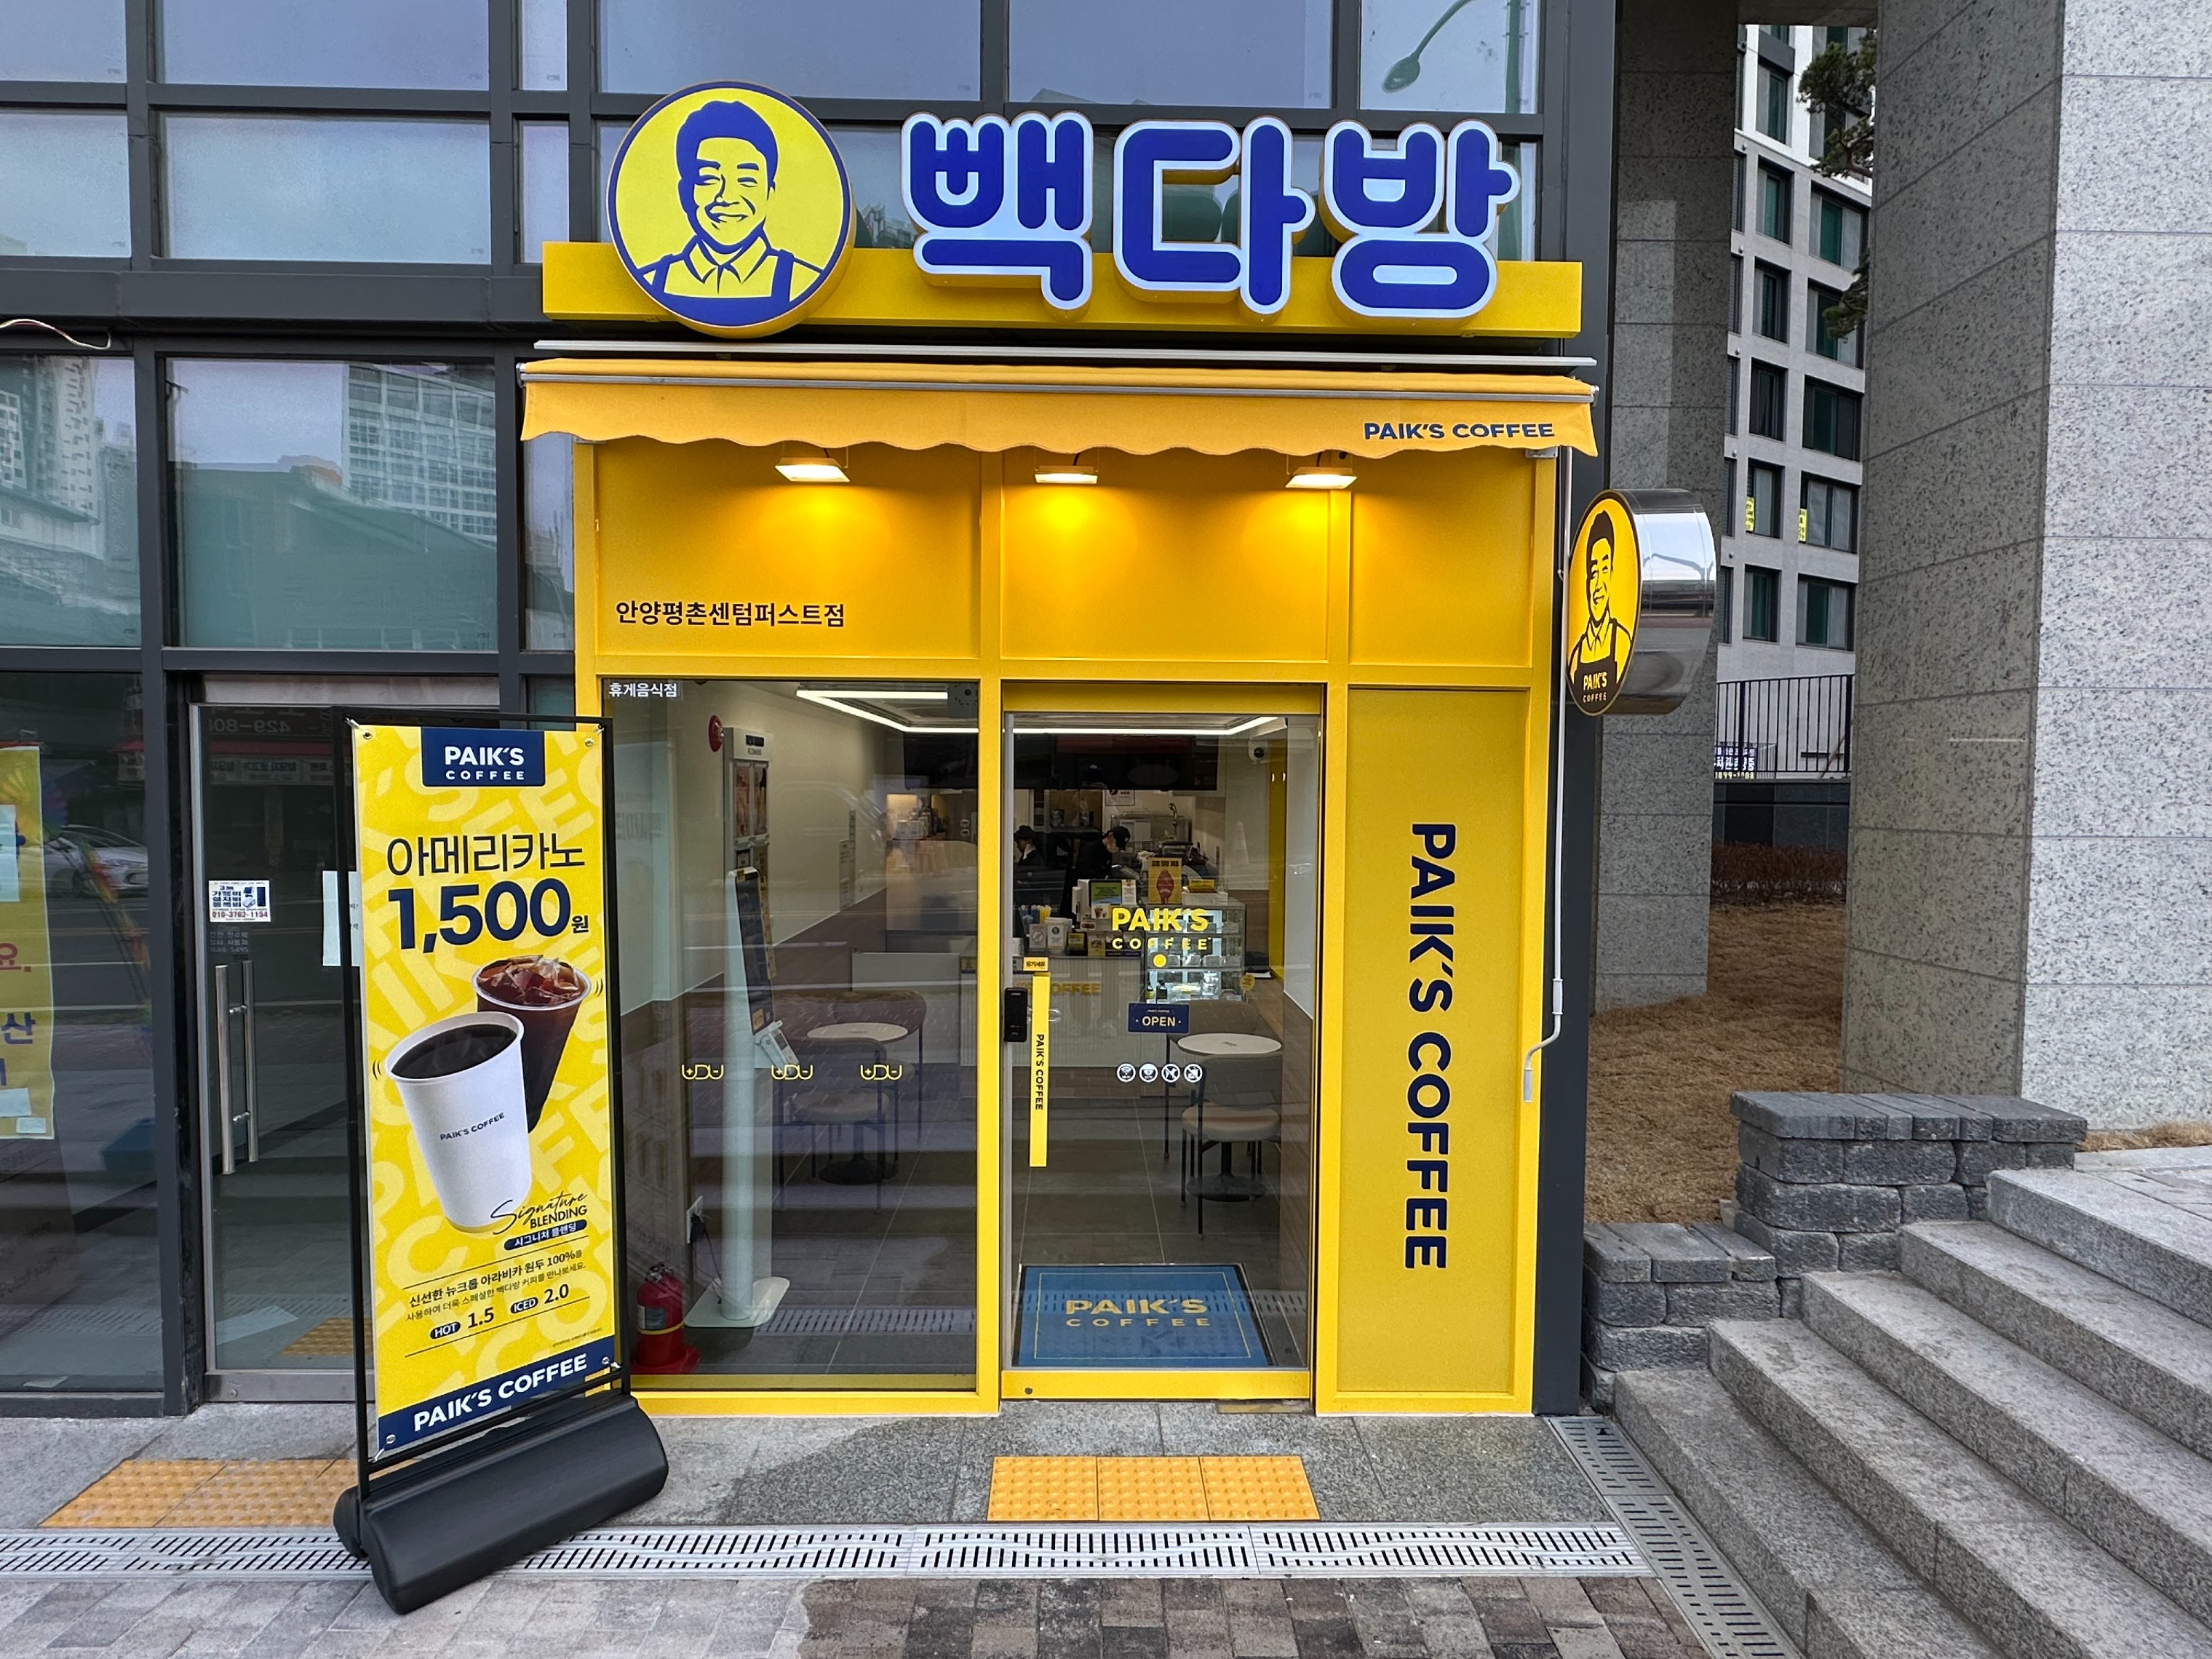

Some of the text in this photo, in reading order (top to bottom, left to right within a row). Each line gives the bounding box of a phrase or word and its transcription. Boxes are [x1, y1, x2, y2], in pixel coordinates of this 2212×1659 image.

[901, 111, 1521, 319] 백다방
[1364, 422, 1555, 439] PAIK'S COFFEE
[616, 600, 846, 628] 안양평촌센텀퍼스트점
[608, 682, 678, 698] 휴게음식점
[1583, 671, 1608, 691] PAIK'S
[1582, 691, 1607, 704] COFFEE
[445, 746, 525, 766] PAIK'S
[445, 770, 525, 781] COFFEE
[387, 832, 586, 877] 아메리카노
[1112, 907, 1209, 931] PAIK'S
[1112, 937, 1209, 950] COFFEE
[1050, 982, 1102, 995] OFFEE
[1142, 1016, 1176, 1027] OPEN
[1405, 823, 1456, 1269] PAIK'S COFFEE
[1035, 1034, 1045, 1110] PAIK'S COFFEE
[439, 1112, 505, 1141] PAIK'S COFFEE
[490, 1190, 588, 1236] Signature
[530, 1205, 588, 1229] BLENDING
[514, 1222, 577, 1246] 시그니처 블렌딩
[409, 1249, 583, 1308] 신선한 뉴크롭 아라비카 원두 100%를
[405, 1261, 586, 1321] 사용하여 더욱 스페셜한 백다방 커피를 만나보세요.
[434, 1283, 570, 1338] HOT 1.5 ICED 2.0
[1065, 1298, 1209, 1315] PAIK'S
[1065, 1317, 1211, 1326] COFFEE
[413, 1353, 587, 1432] PAIK'S COFFEE
